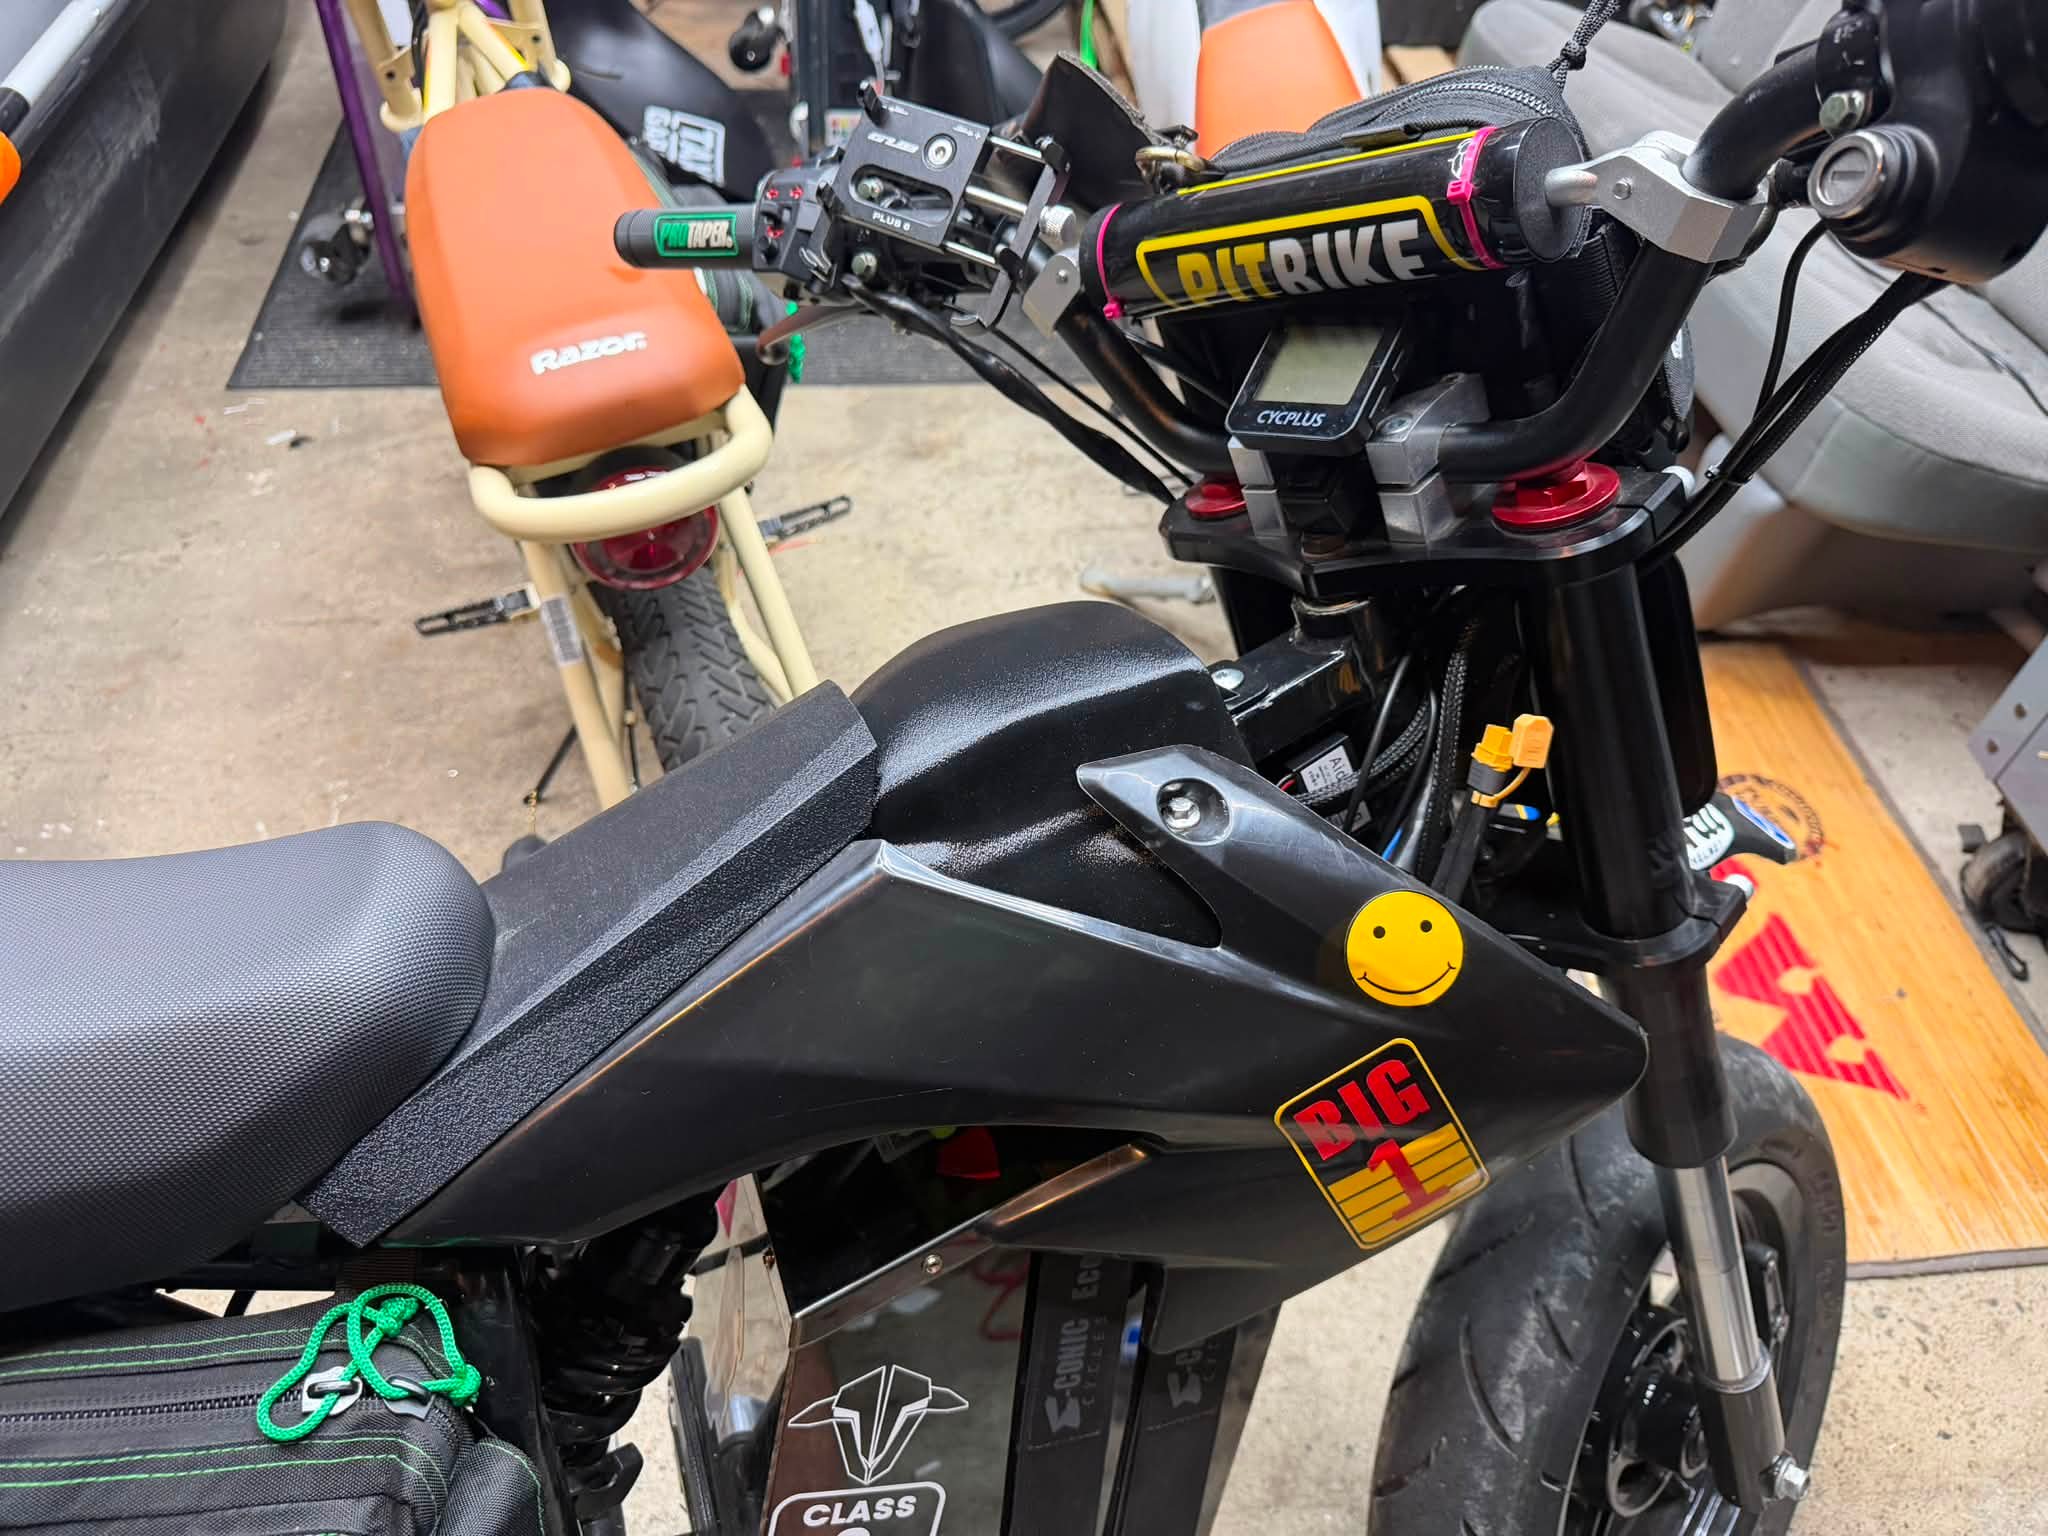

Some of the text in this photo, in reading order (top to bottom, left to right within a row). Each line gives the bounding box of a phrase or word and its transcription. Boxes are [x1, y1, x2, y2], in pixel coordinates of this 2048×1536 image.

[530, 331, 646, 375] Razor
[1257, 409, 1326, 427] CYCPLUS
[1293, 1059, 1431, 1161] BIG
[1367, 1138, 1450, 1221] 1
[803, 1495, 917, 1528] CLASS
